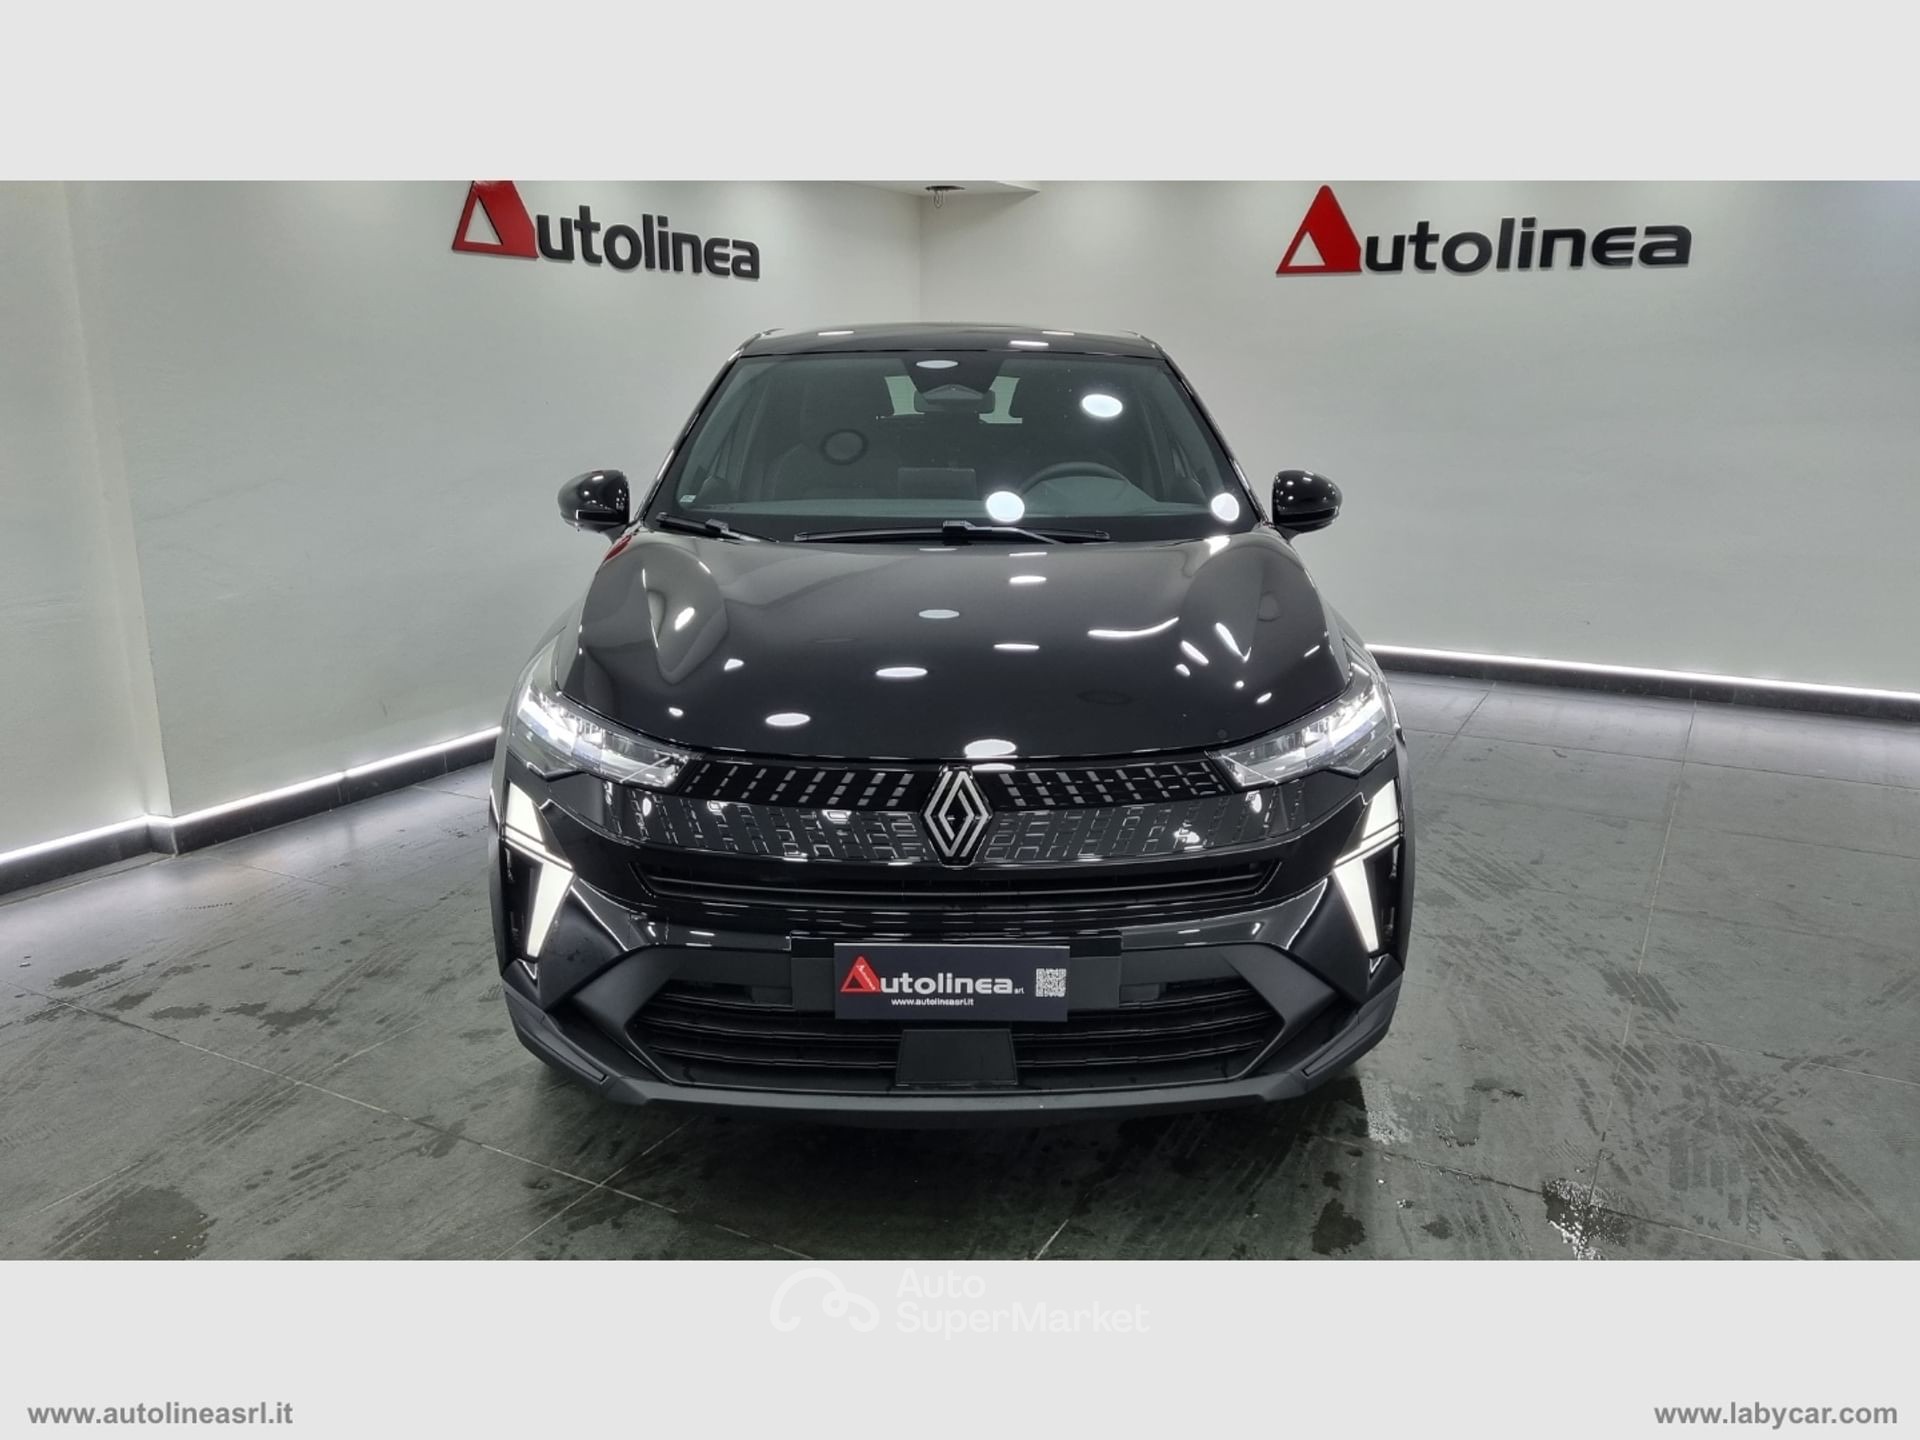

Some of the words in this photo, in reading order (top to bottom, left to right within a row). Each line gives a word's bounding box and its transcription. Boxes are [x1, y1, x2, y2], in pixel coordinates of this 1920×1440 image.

[452, 181, 760, 279] Autolinea
[1276, 185, 1692, 275] Autolinea
[840, 956, 1013, 994] Autolinea
[891, 998, 974, 1006] www.autolineasrl.it
